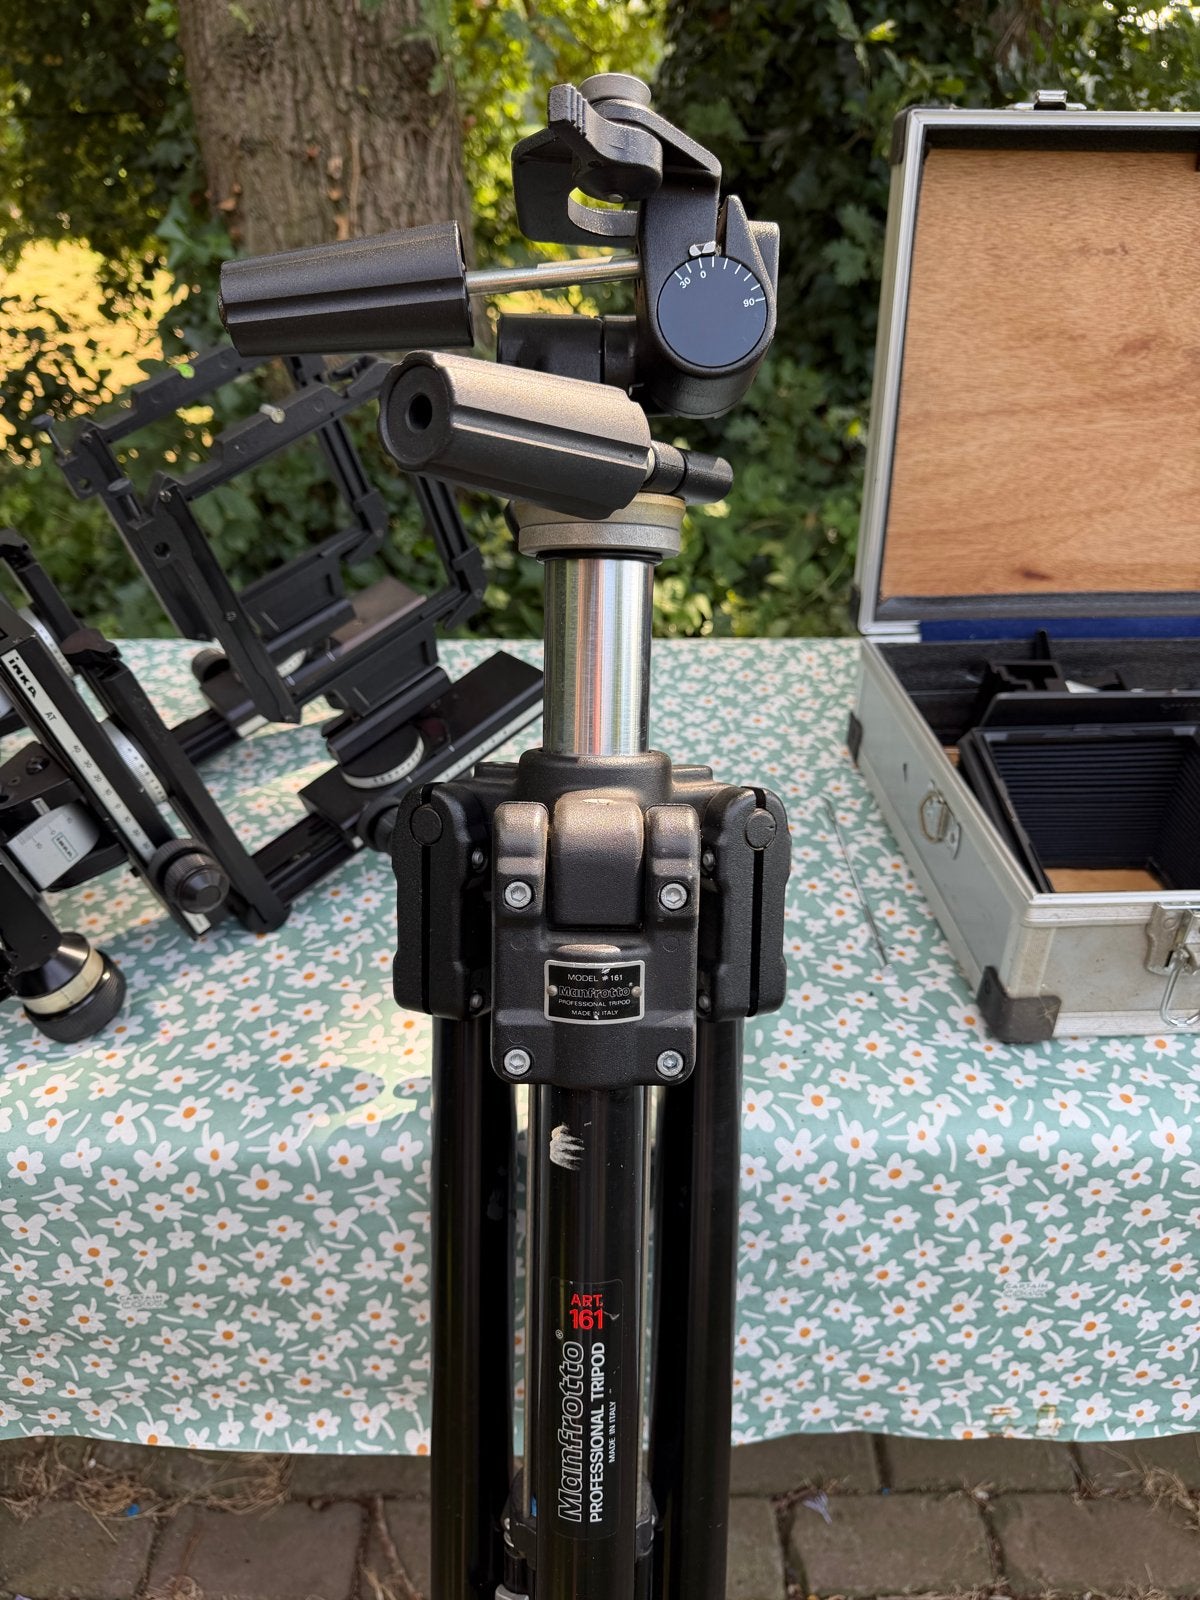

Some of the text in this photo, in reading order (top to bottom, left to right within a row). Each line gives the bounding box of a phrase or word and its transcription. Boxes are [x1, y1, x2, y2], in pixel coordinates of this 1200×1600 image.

[680, 270, 755, 307] 30 0 90
[45, 712, 57, 721] AT
[567, 974, 599, 982] MODEL
[559, 986, 631, 998] Manfrotto
[558, 999, 606, 1007] PROFESSIONAL
[569, 1309, 603, 1330] 161
[558, 1341, 584, 1523] Manfrotto
[590, 1342, 605, 1523] PROFESSIONAL TRIPOD
[609, 1424, 616, 1435] IN
[608, 1437, 616, 1463] MADE
